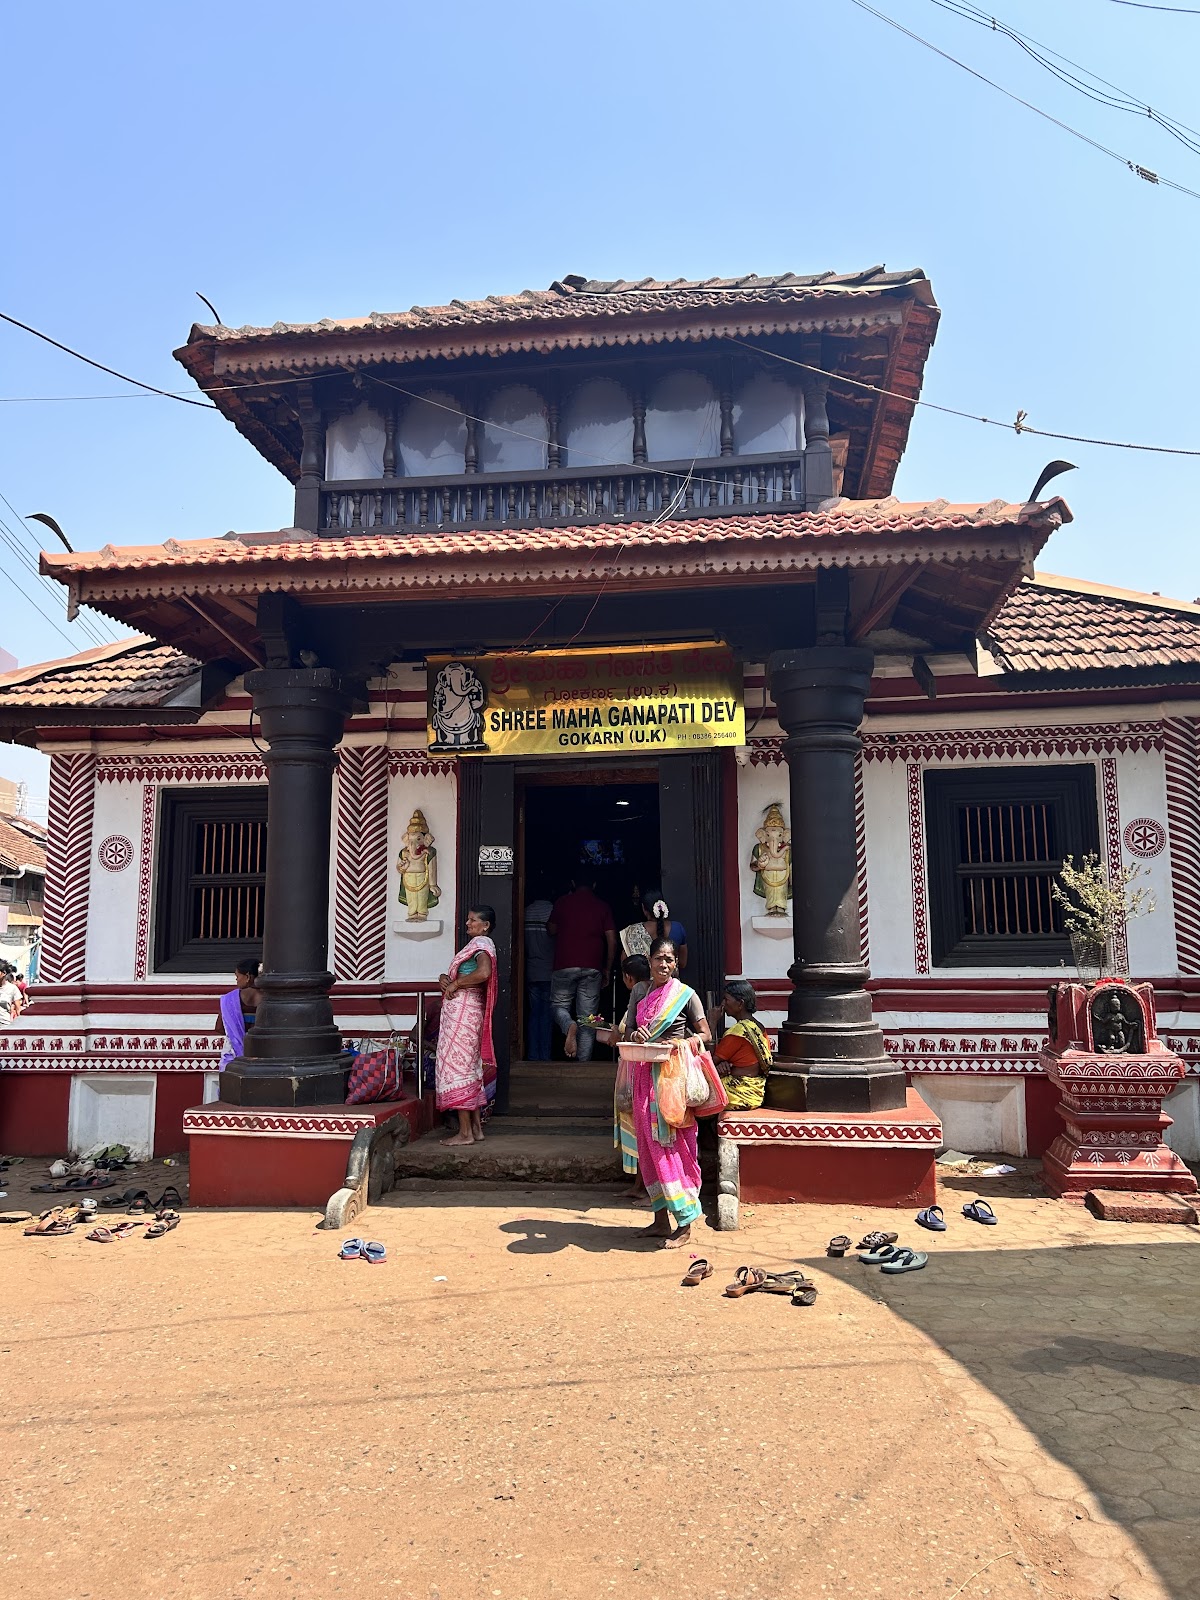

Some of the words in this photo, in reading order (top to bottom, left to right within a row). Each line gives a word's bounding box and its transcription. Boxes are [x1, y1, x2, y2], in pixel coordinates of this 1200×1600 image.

[595, 650, 674, 679] ಗಣಪತಿ
[544, 685, 617, 702] ಗೋಕರ್ಣ
[490, 708, 547, 732] SHREE
[552, 706, 603, 729] MAHA
[608, 702, 696, 727] GANAPATI
[701, 701, 738, 723] DEV
[558, 731, 625, 746] GOKARN
[629, 728, 667, 745] (U.K)
